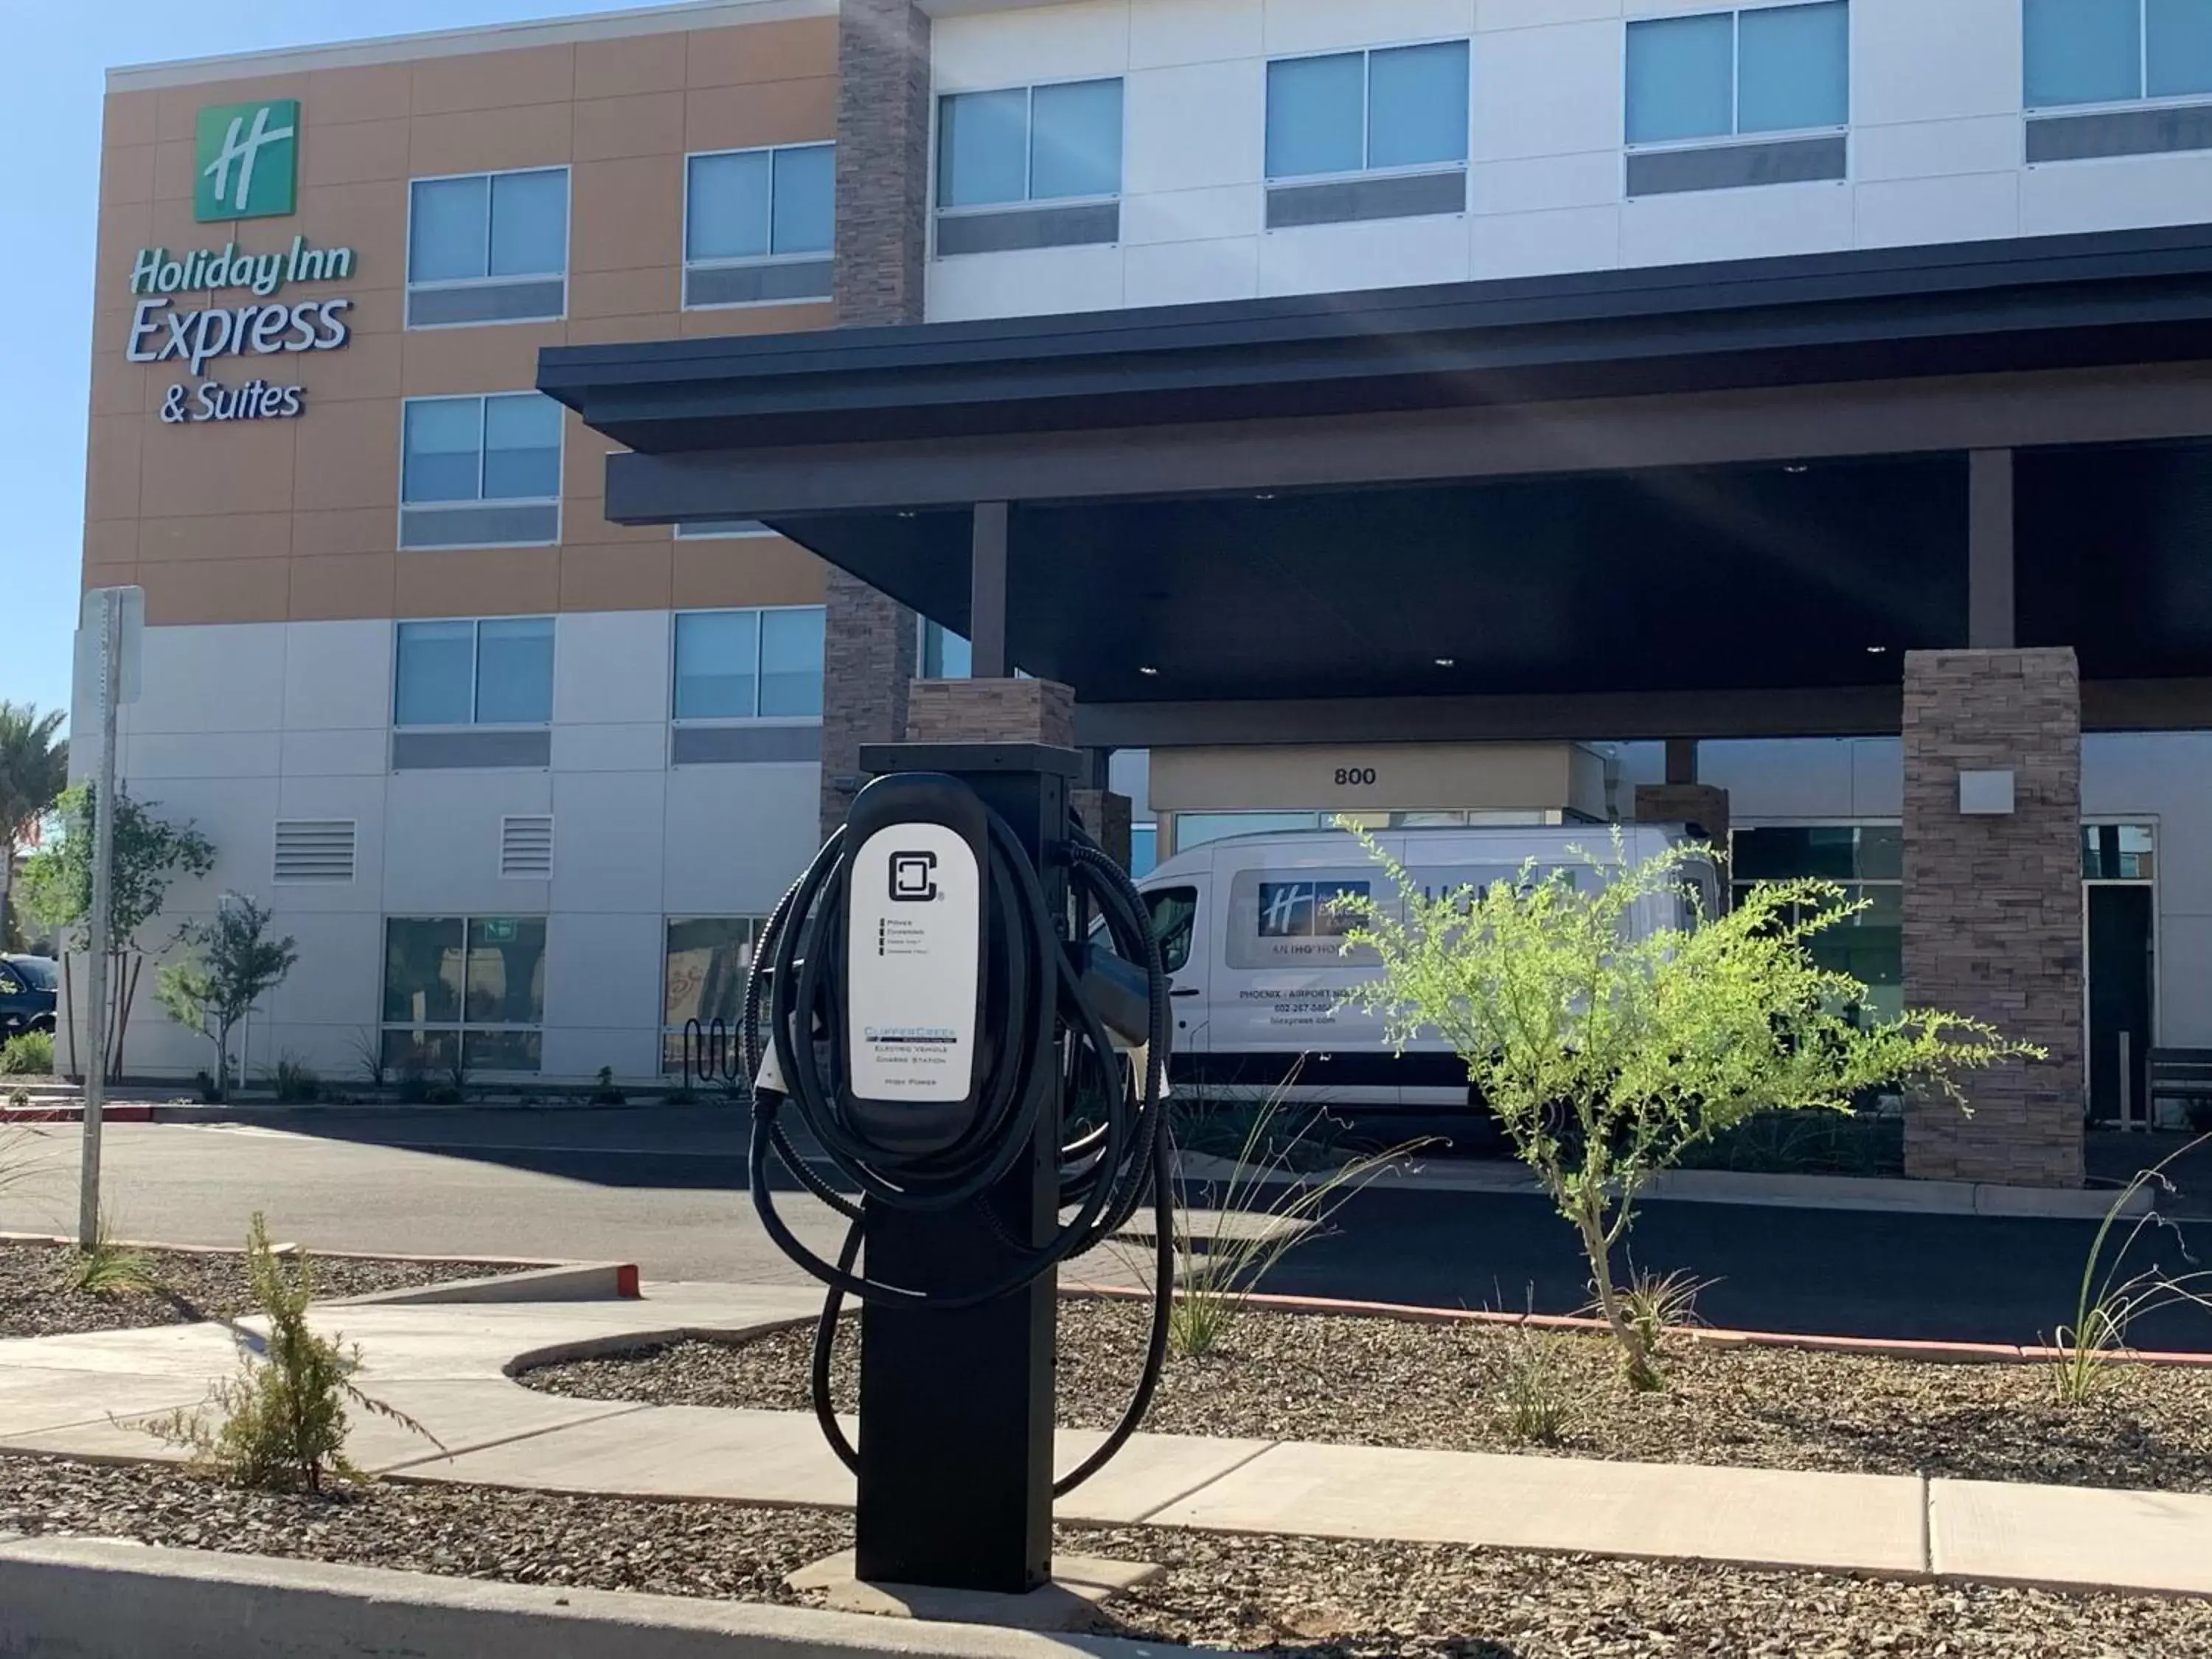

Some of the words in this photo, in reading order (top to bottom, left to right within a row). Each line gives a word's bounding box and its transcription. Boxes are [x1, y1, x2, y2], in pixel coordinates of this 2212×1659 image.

[129, 242, 282, 296] Holiday
[287, 235, 353, 282] Inn
[126, 298, 349, 376] Express
[161, 383, 186, 422] &
[193, 380, 302, 422] Suites
[1334, 768, 1377, 785] 800
[1239, 990, 1281, 999] PHOENIX
[1289, 990, 1330, 999] AIRPORT
